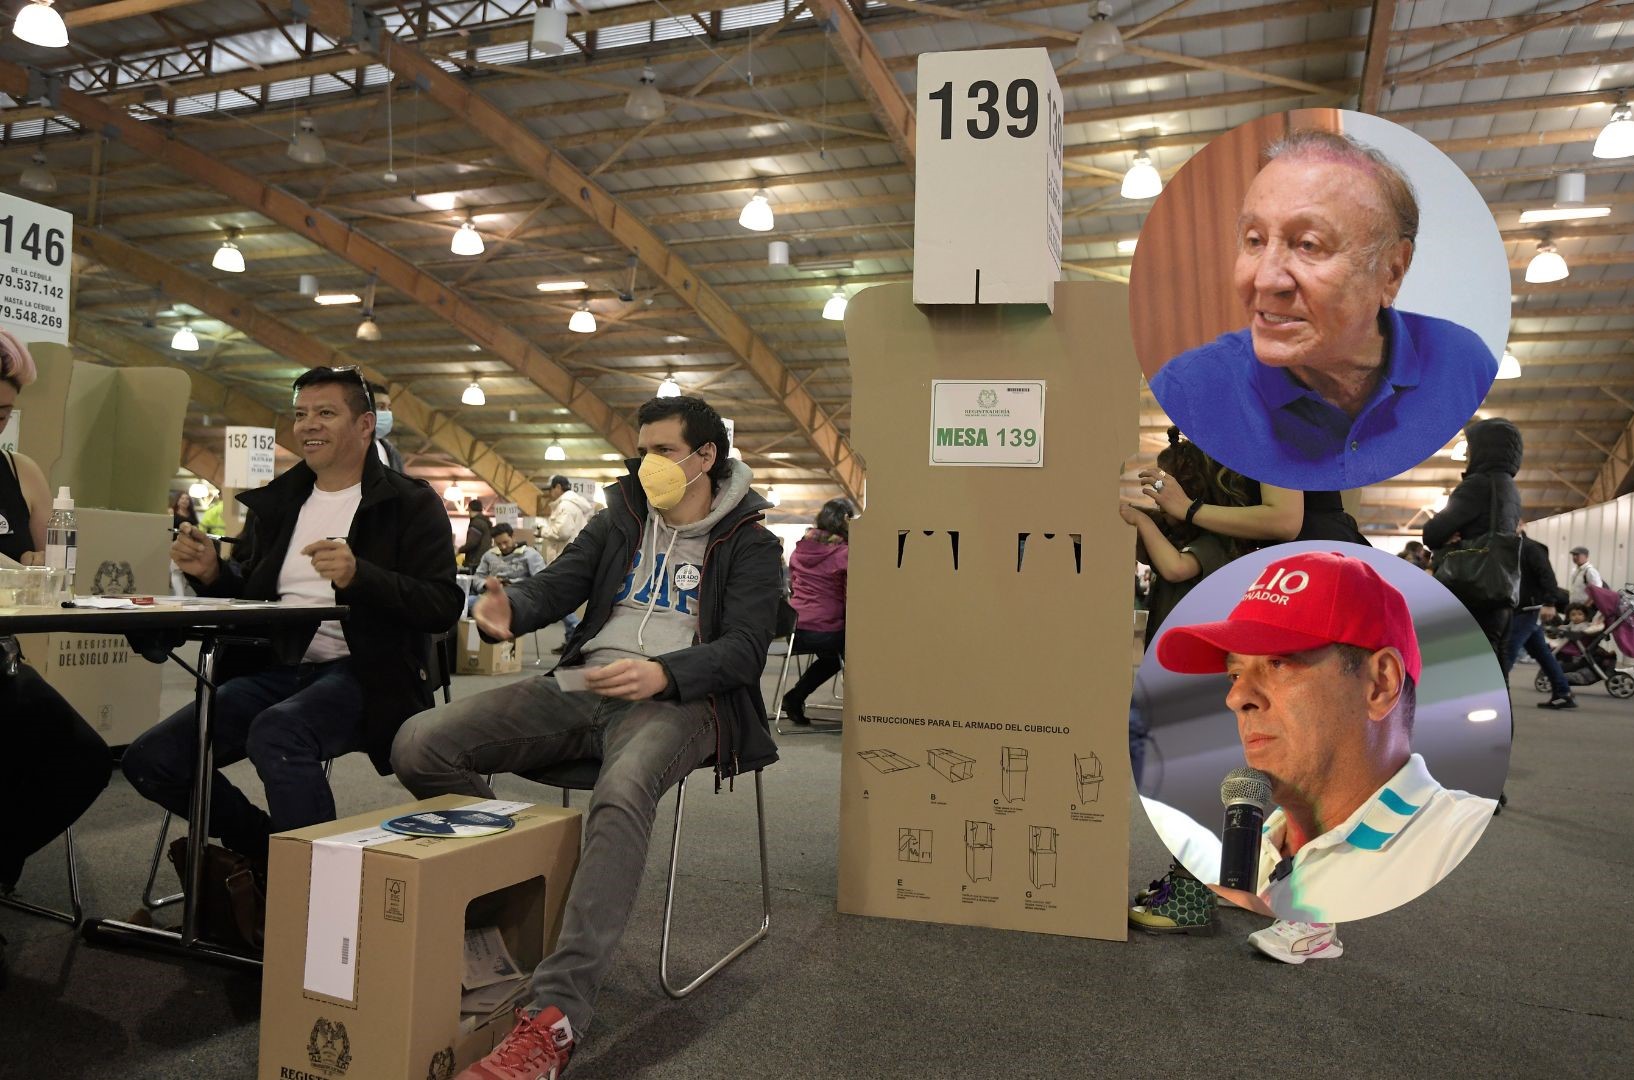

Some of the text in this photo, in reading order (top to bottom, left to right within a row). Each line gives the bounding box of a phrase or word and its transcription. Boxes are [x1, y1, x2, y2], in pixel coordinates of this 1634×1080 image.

[928, 78, 1040, 140] 139
[1047, 88, 1063, 170] 139
[0, 215, 64, 267] 146
[11, 266, 18, 274] DE
[20, 268, 28, 277] LA
[0, 273, 64, 299] 79.537.142
[4, 296, 23, 305] HASTA
[25, 299, 33, 308] LA
[228, 434, 248, 448] 152
[252, 435, 274, 450] 152
[936, 428, 1037, 447] MESA 139
[1243, 590, 1290, 605] NADOR
[60, 640, 71, 651] LA
[59, 651, 128, 667] DEL SIGLO XXI
[858, 715, 1070, 735] INSTRUCCIONES PARA EL ARMADO DEL CUBICULO
[930, 793, 937, 801] B
[993, 798, 1000, 806] C
[1070, 804, 1077, 812] D
[897, 878, 903, 886] E
[961, 884, 967, 892] F
[1025, 890, 1032, 899] G
